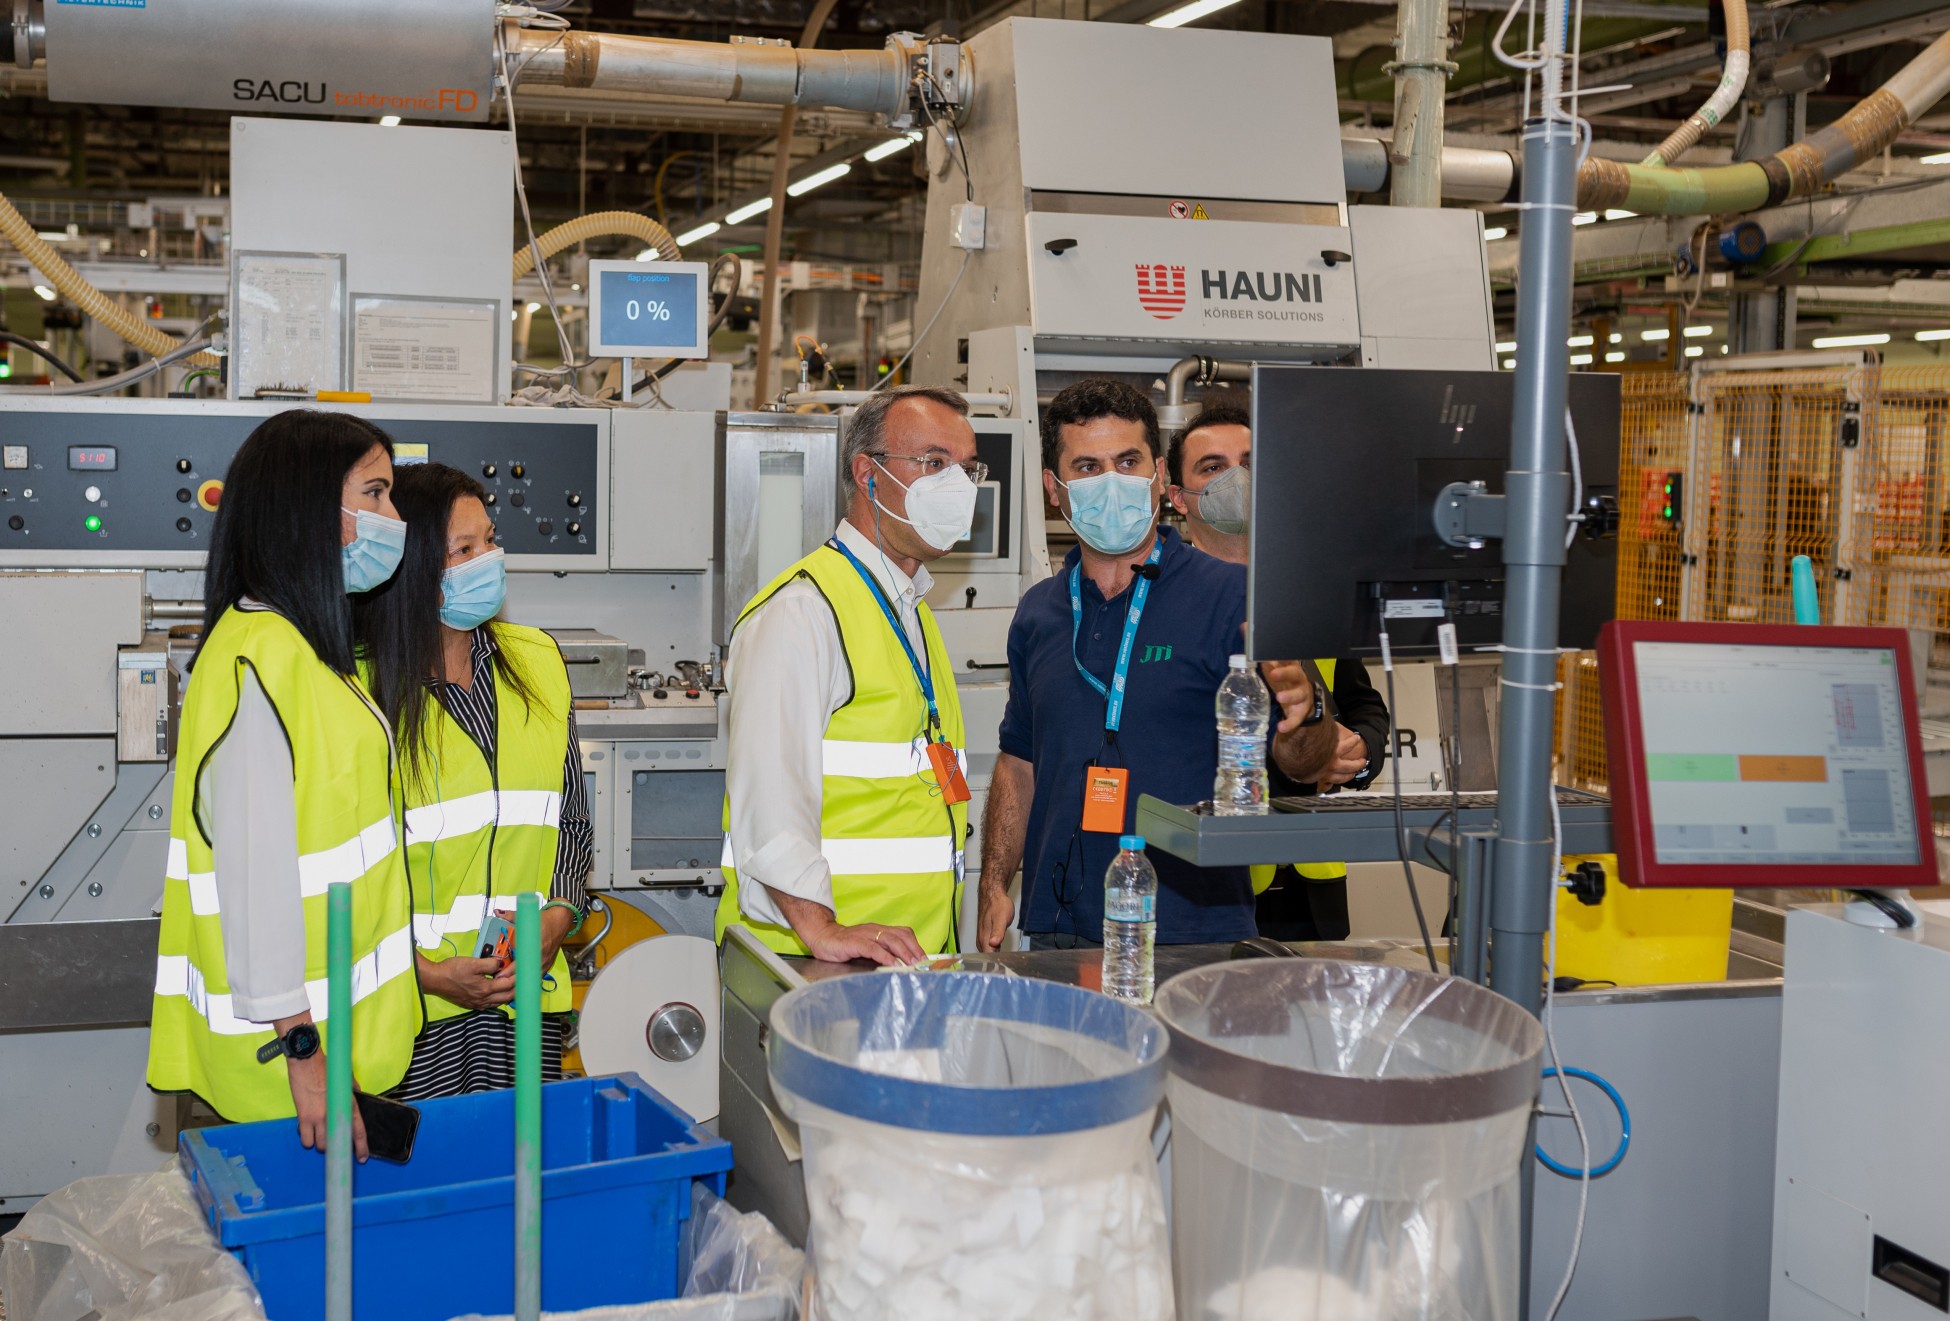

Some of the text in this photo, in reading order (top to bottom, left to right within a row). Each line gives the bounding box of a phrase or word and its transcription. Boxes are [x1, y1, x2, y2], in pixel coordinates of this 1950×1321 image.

[233, 78, 326, 104] SACU
[642, 274, 670, 283] position
[1201, 269, 1323, 303] HAUNI
[626, 299, 671, 321] 0 %
[1204, 308, 1325, 322] KÖRBER SOLUTIONS
